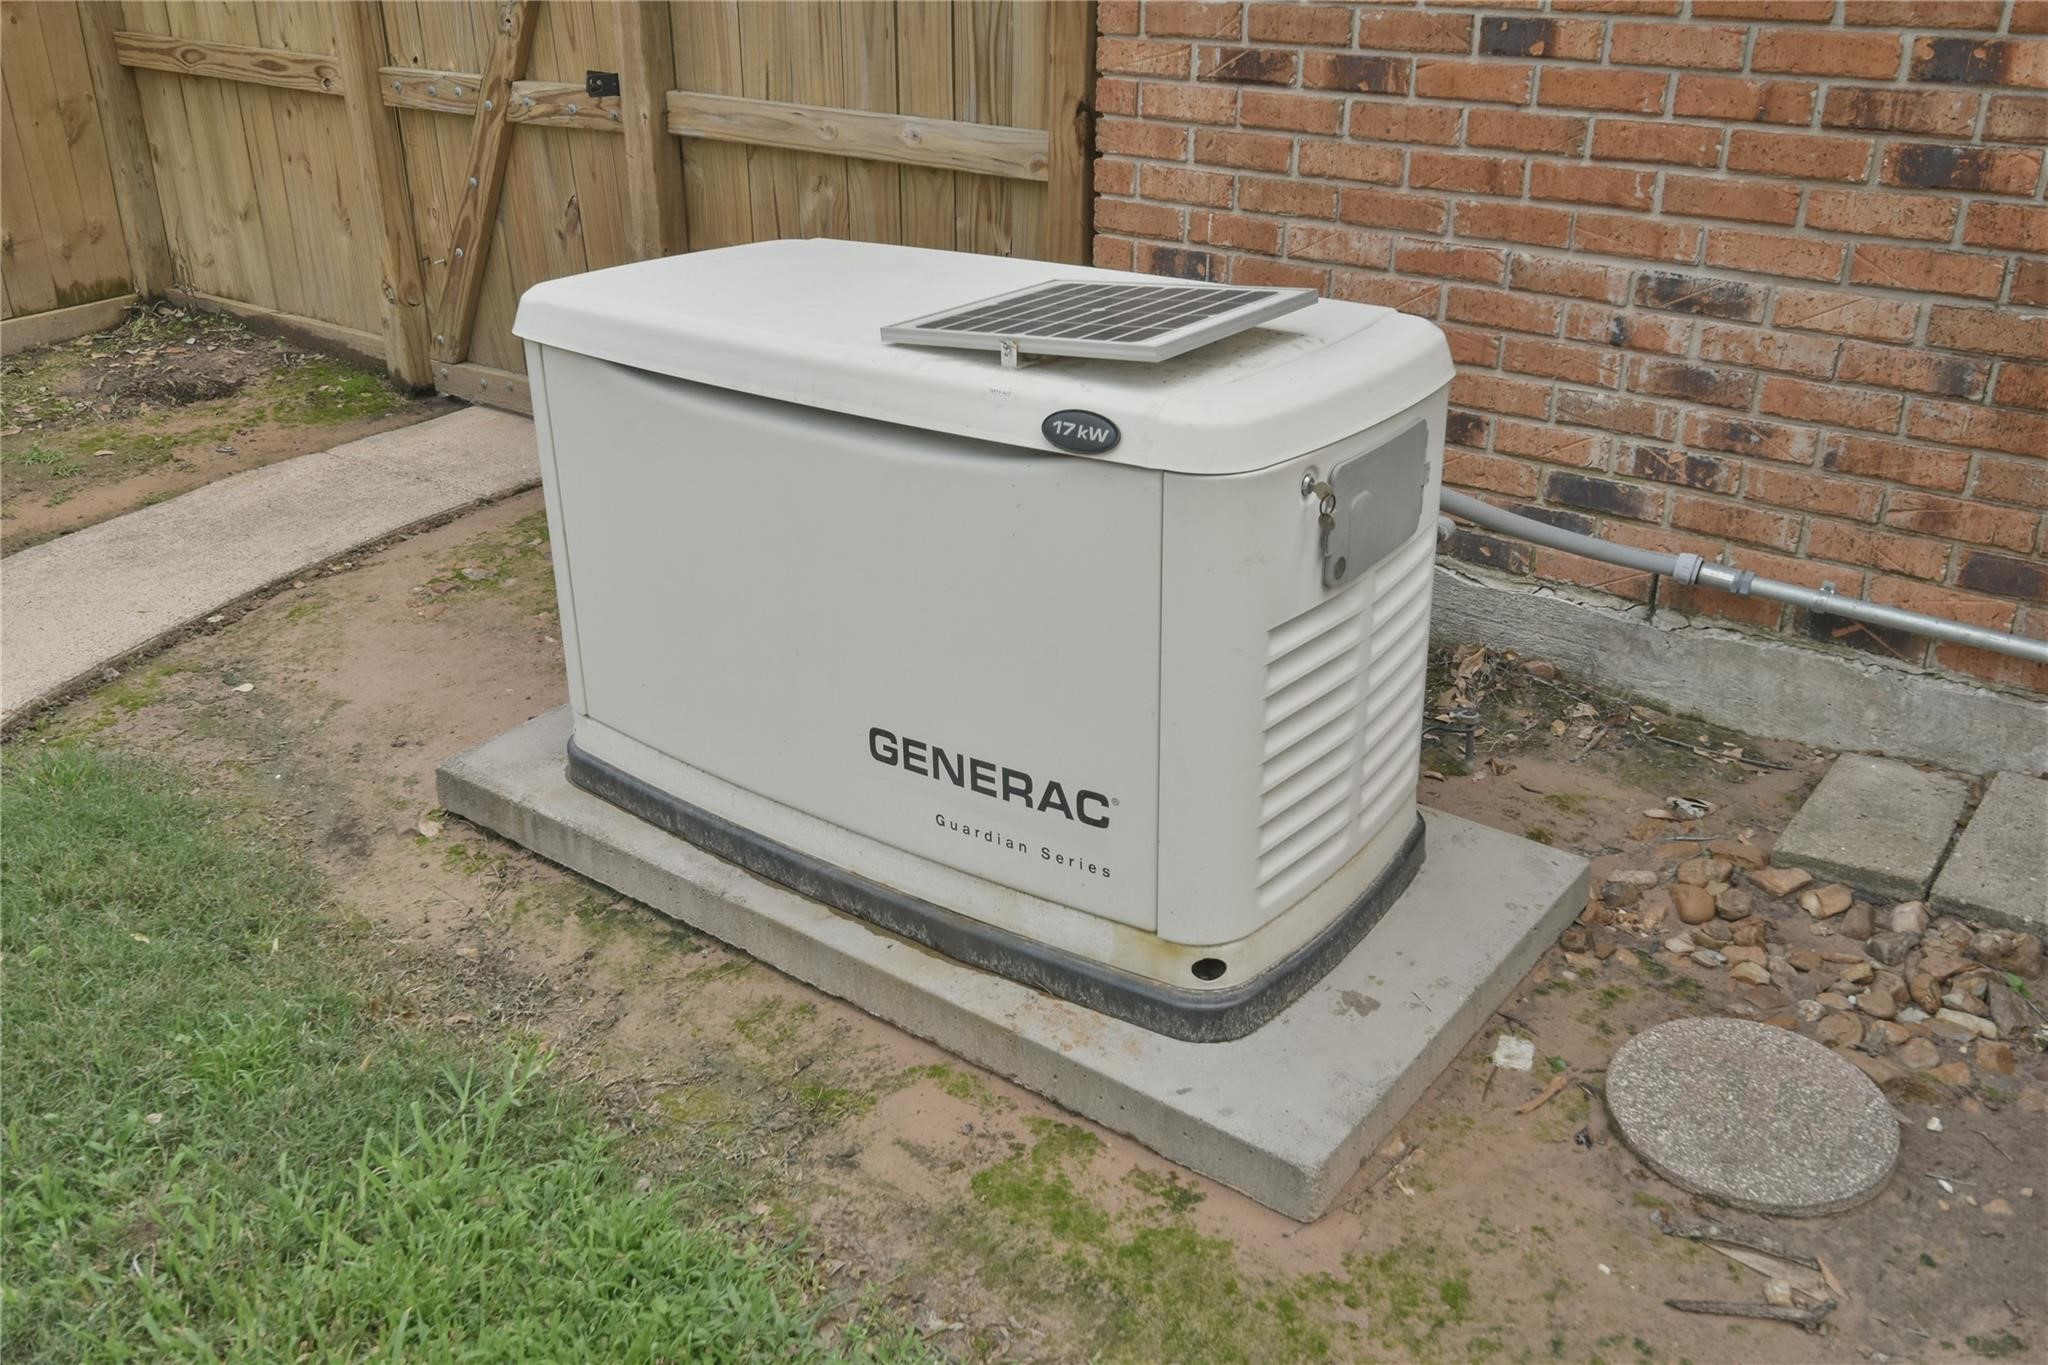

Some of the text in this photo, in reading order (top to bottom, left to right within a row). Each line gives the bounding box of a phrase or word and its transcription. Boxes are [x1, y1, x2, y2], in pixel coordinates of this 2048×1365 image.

[1053, 420, 1109, 443] 17 kW
[869, 727, 1110, 829] GENERAC
[935, 814, 1111, 878] Guardian Series
